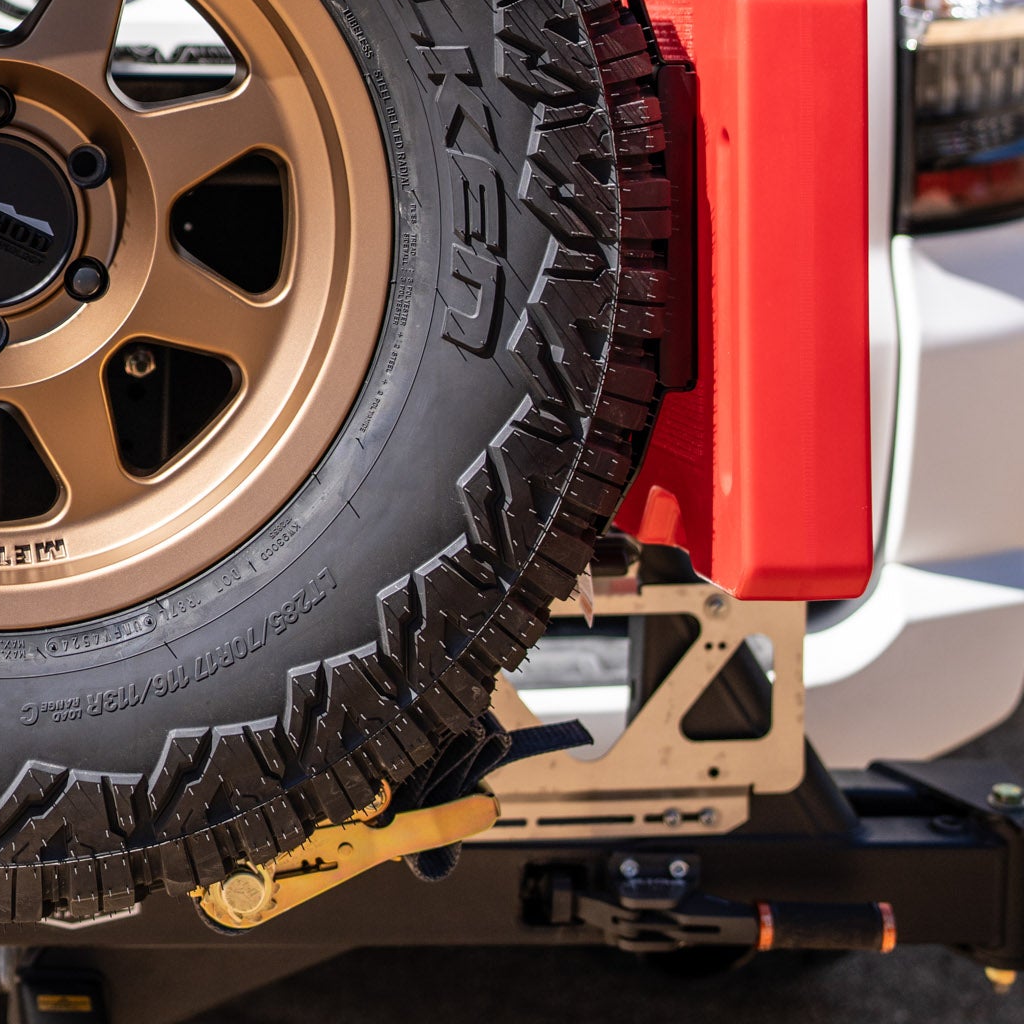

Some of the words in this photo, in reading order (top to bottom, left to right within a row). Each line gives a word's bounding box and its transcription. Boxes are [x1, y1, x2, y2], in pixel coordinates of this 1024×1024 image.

[341, 6, 375, 60] TUBELESS
[372, 68, 392, 103] STEEL
[386, 105, 404, 148] BELTED
[397, 150, 410, 191] RADIAL
[399, 285, 413, 327] POLYESTER
[211, 566, 243, 594] DOT
[189, 566, 338, 682] LT285/70R17
[40, 695, 83, 712] RANGE
[86, 664, 192, 718] 116/113R
[18, 701, 42, 726] C
[50, 707, 84, 723] LOAD
